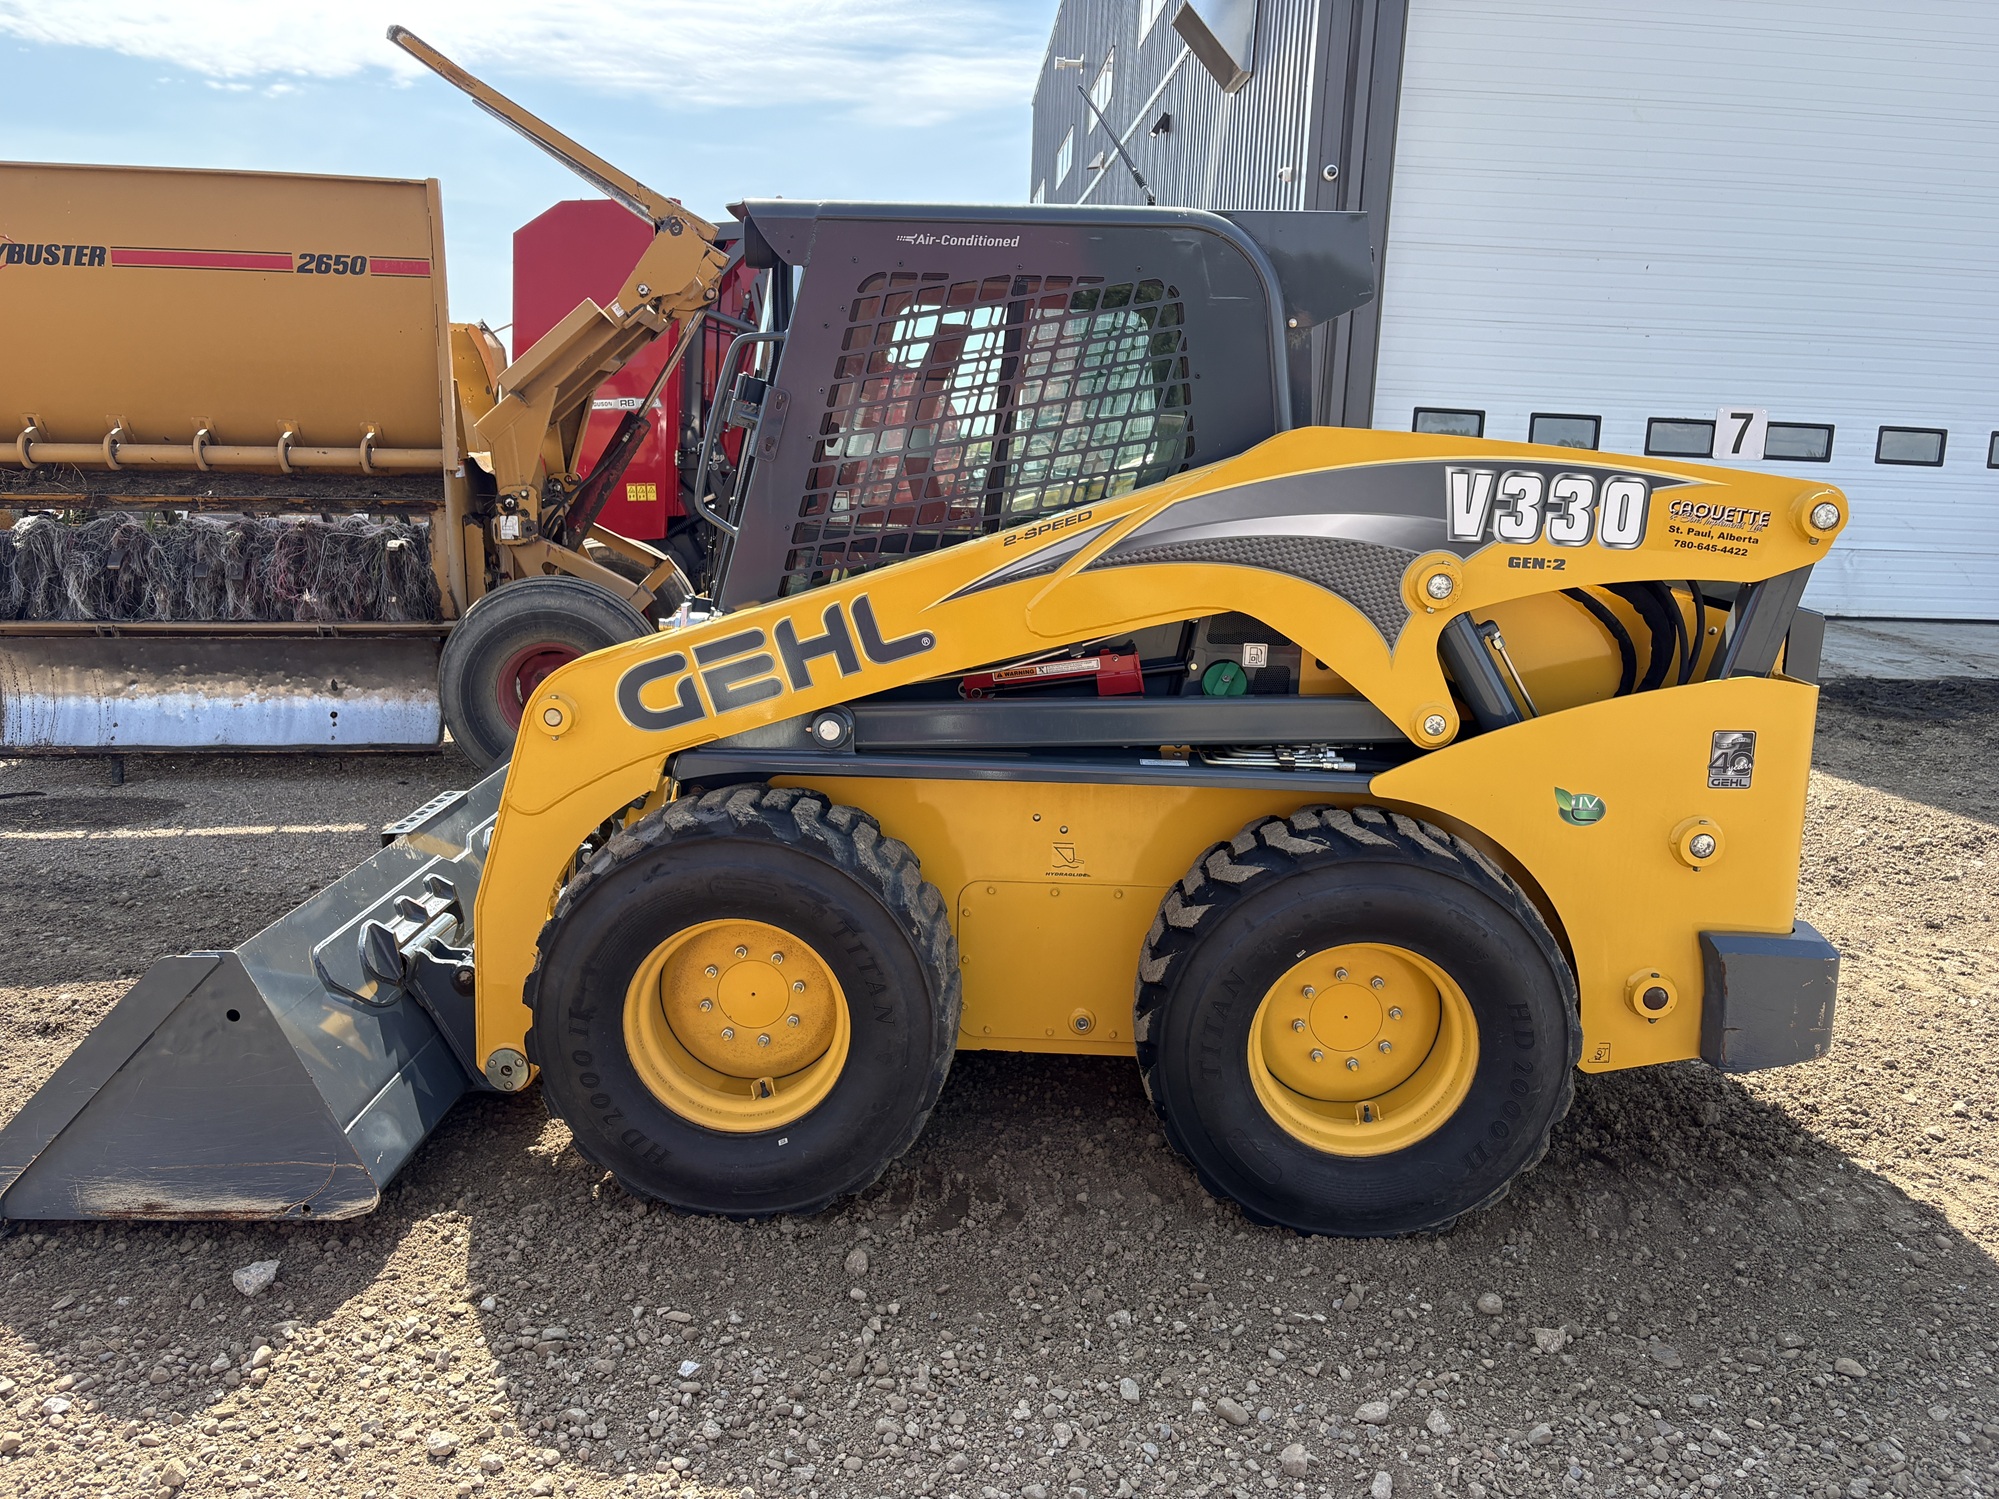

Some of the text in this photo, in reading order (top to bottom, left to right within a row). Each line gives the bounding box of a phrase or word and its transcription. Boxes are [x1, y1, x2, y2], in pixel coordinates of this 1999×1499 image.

[916, 233, 1020, 247] Air-Conditioned
[296, 253, 366, 276] 2650
[1730, 412, 1754, 454] 7
[1446, 466, 1653, 549] V330
[1668, 499, 1771, 528] CAOUETTE
[1003, 510, 1093, 547] 2-SPEED
[1668, 525, 1759, 544] St. Paul, Alberta
[1673, 540, 1748, 556] 780-645-4422
[1508, 556, 1566, 571] GEN:2
[615, 592, 937, 732] GEHL
[1003, 668, 1036, 678] WARNING
[1711, 778, 1748, 787] GEHL
[832, 920, 896, 1027] TITAN
[1200, 966, 1246, 1081] TITAN
